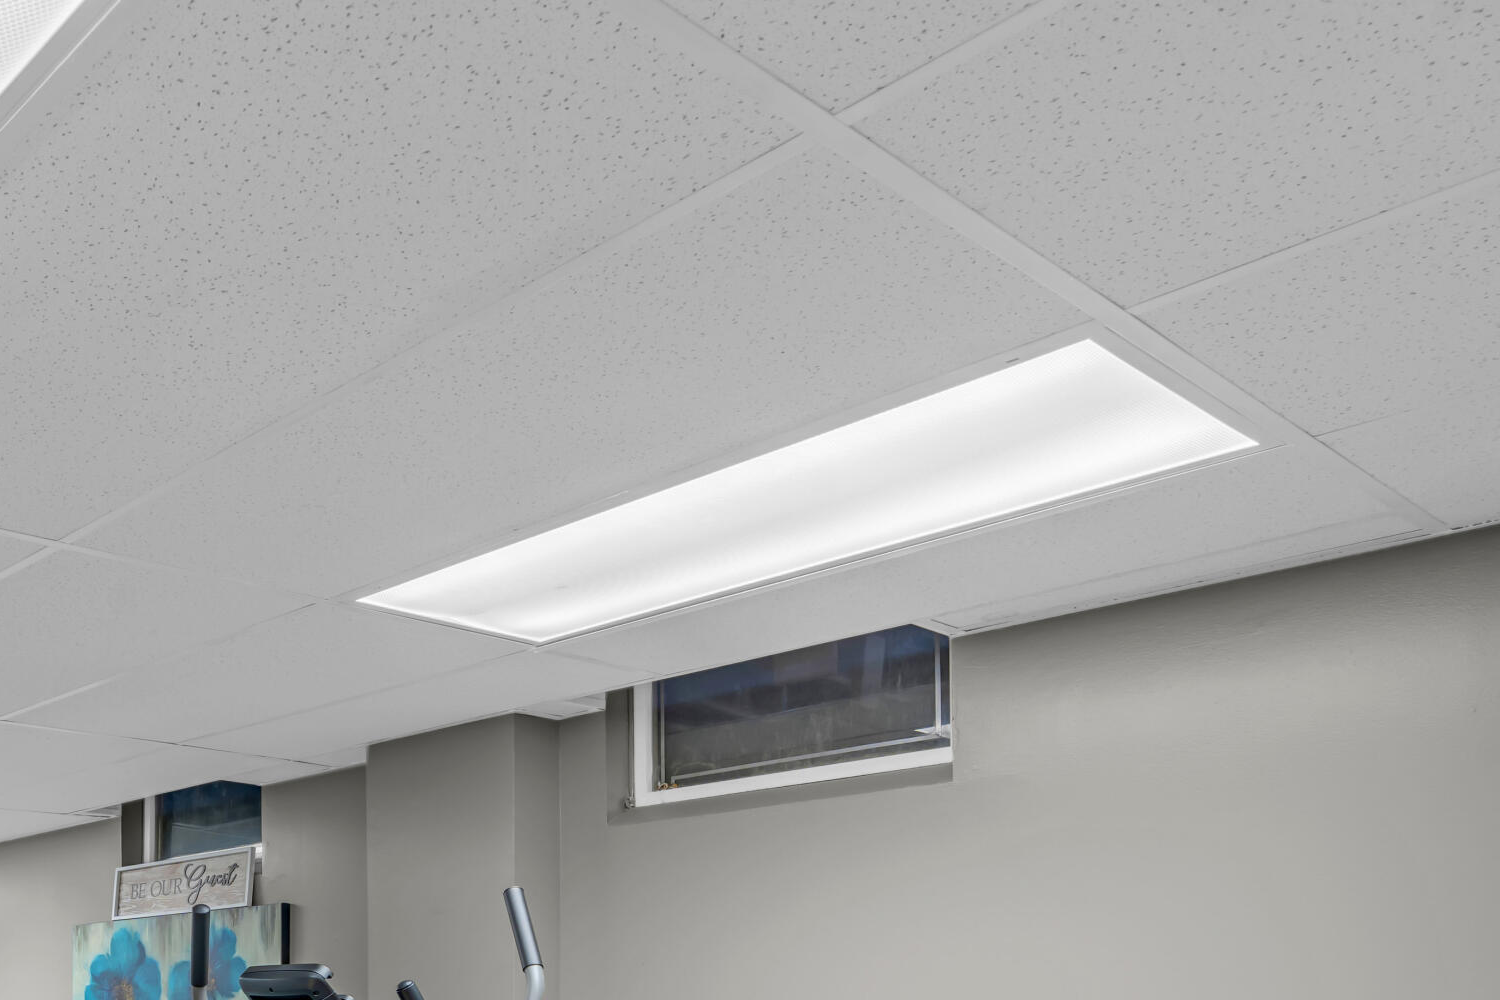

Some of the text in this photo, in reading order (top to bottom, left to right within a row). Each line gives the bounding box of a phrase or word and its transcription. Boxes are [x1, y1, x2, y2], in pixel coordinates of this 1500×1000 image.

[130, 862, 240, 905] BE OUR Guest
